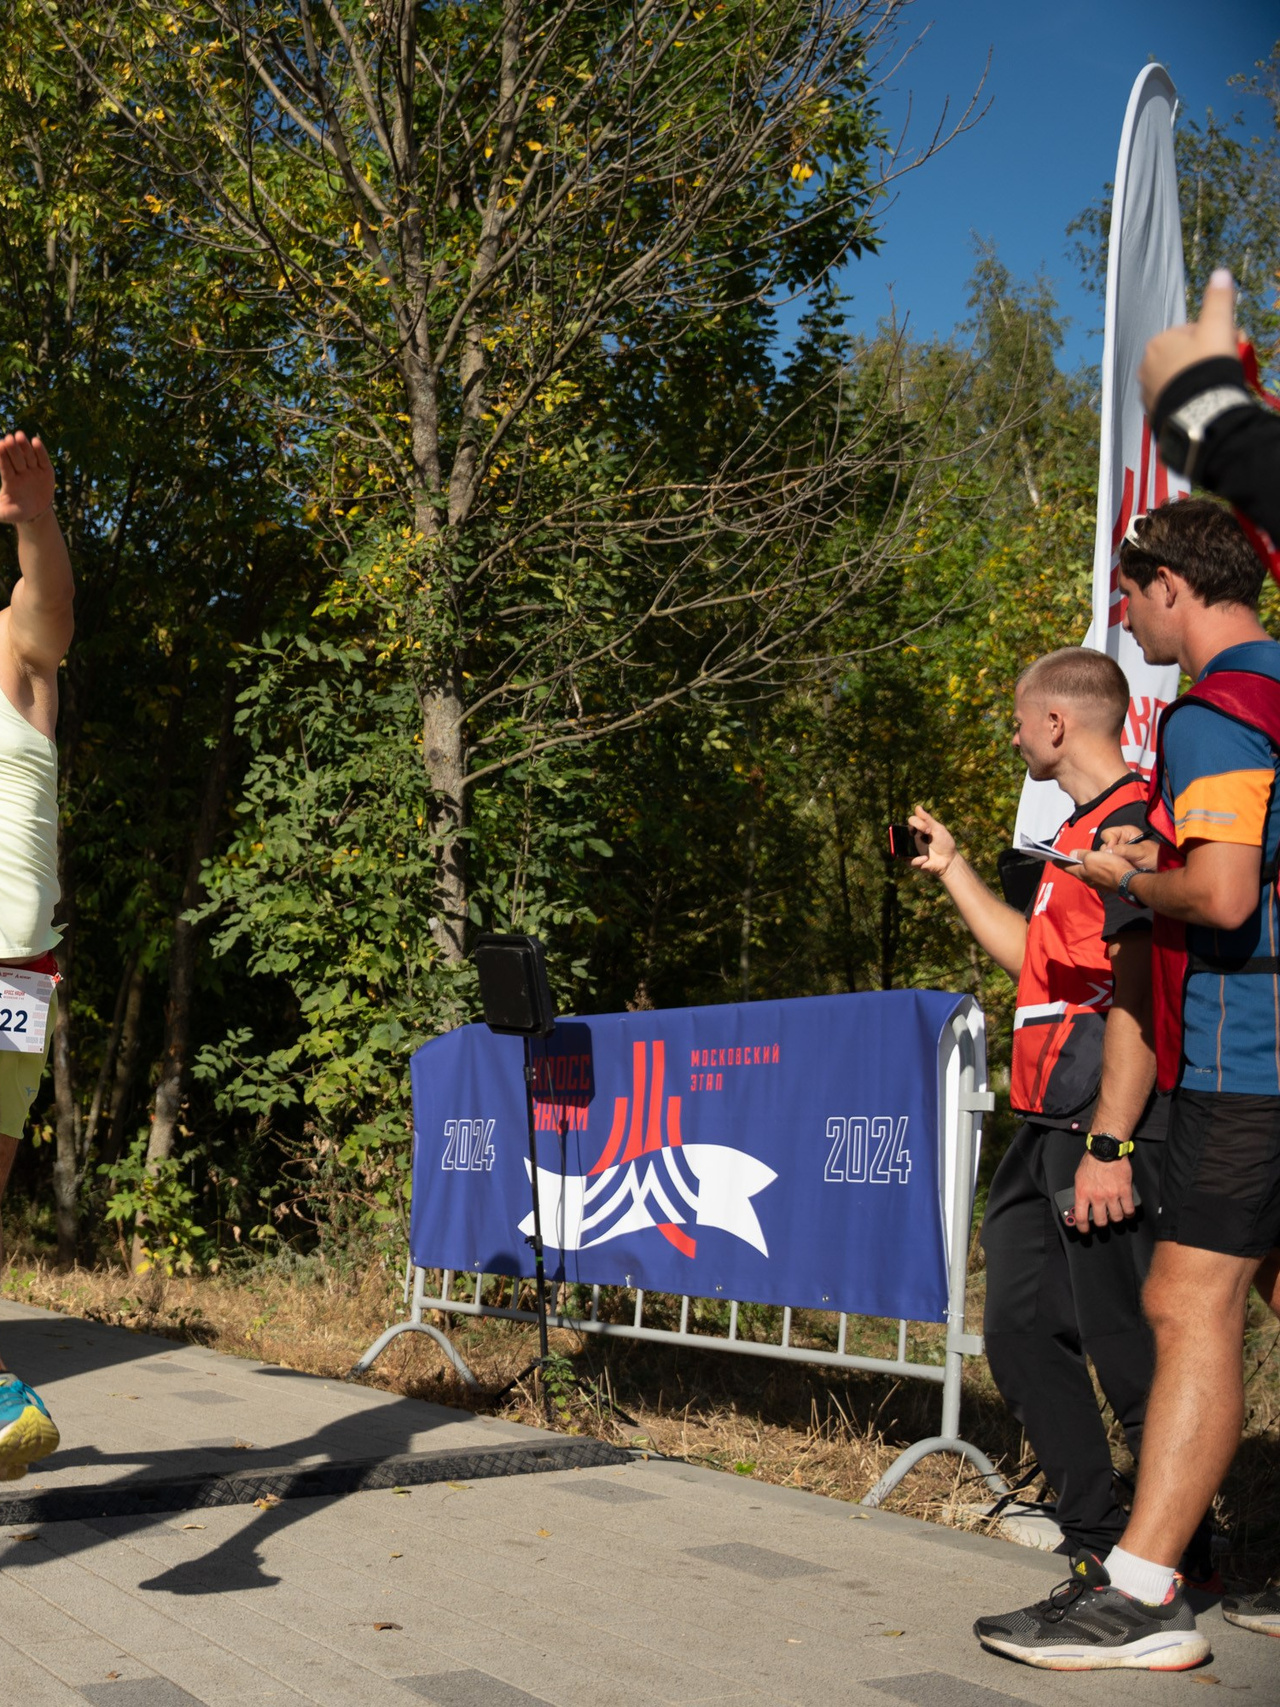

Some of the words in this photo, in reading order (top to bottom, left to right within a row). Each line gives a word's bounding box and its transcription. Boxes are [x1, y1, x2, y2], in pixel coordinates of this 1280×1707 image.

[532, 1053, 591, 1091] КРОСС
[690, 1043, 780, 1067] МОСКОВСКИЙ
[690, 1073, 723, 1092] ЭТАП
[441, 1118, 495, 1171] 2024
[823, 1116, 912, 1184] 2024
